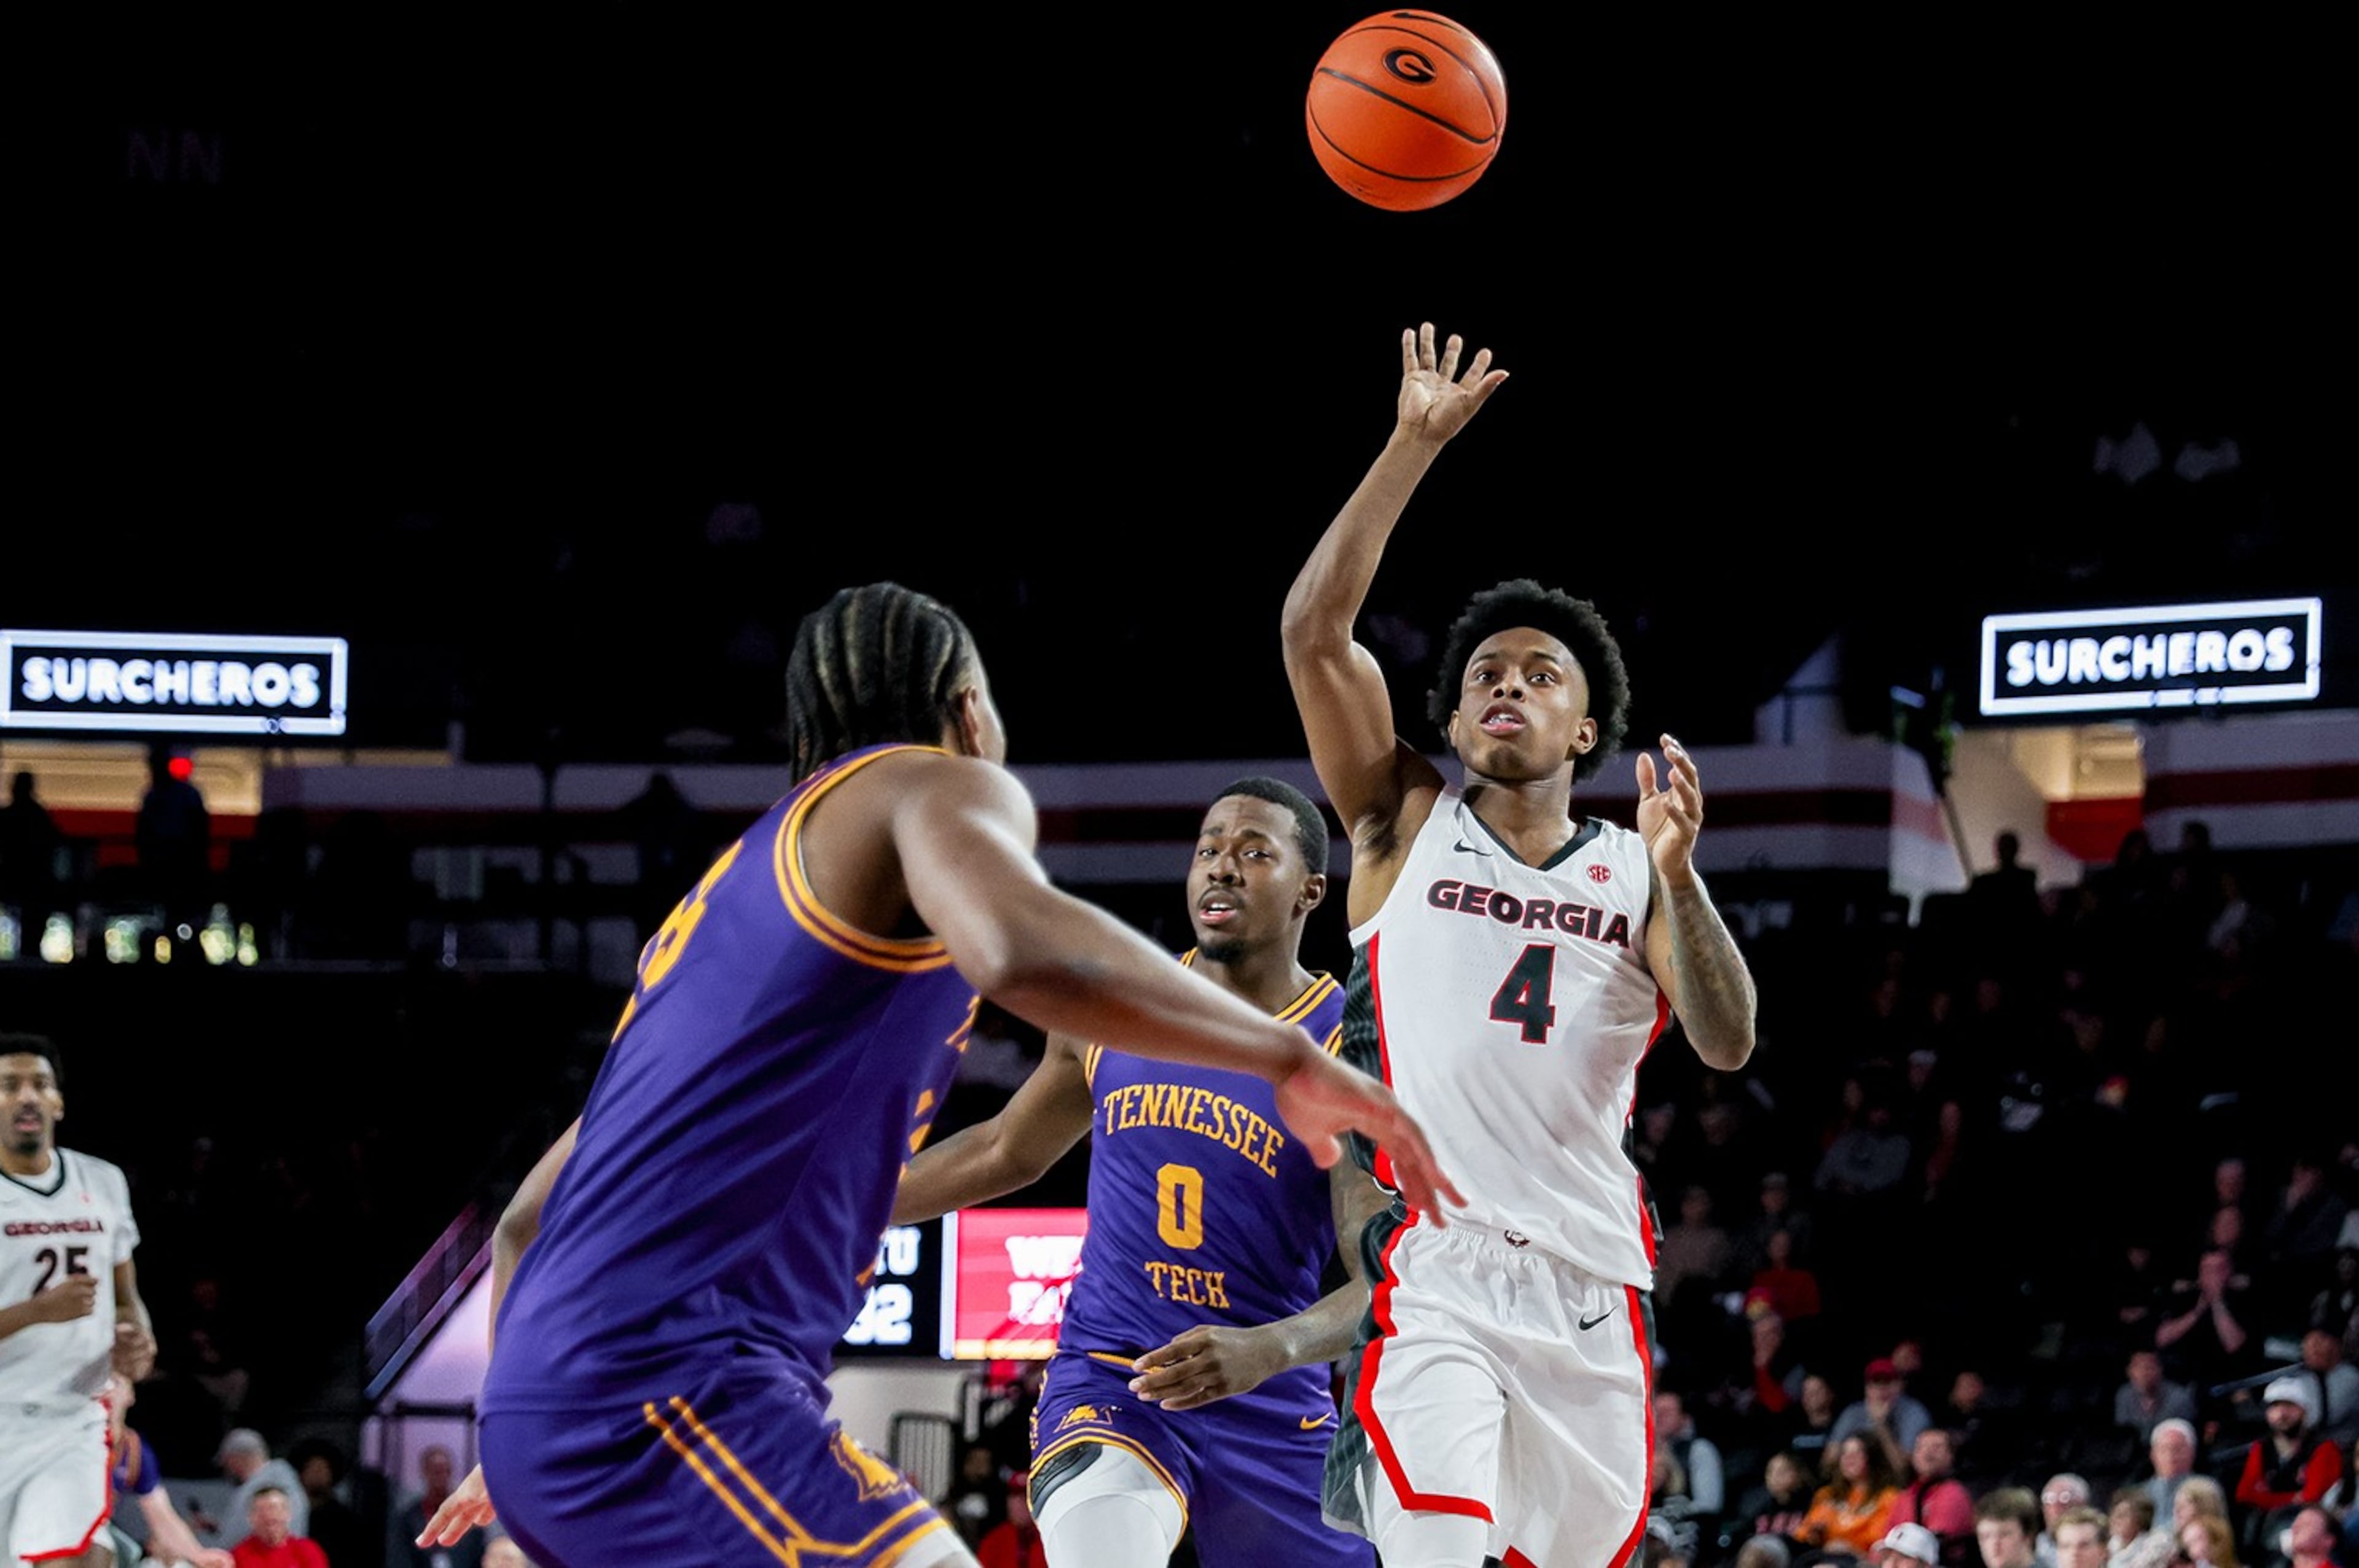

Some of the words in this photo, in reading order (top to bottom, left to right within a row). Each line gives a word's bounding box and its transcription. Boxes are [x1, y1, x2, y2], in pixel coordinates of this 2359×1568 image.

[1383, 48, 1436, 84] G
[21, 656, 321, 709] SURCHEROS
[2006, 626, 2294, 687] SURCHEROS
[1587, 865, 1610, 882] SEC
[1426, 878, 1630, 950] GEORGIA
[1489, 944, 1555, 1044] 4
[1104, 1083, 1285, 1179] TENNESSEE
[1156, 1162, 1204, 1250] 0
[32, 1246, 90, 1296] 25
[1144, 1260, 1230, 1309] TECH
